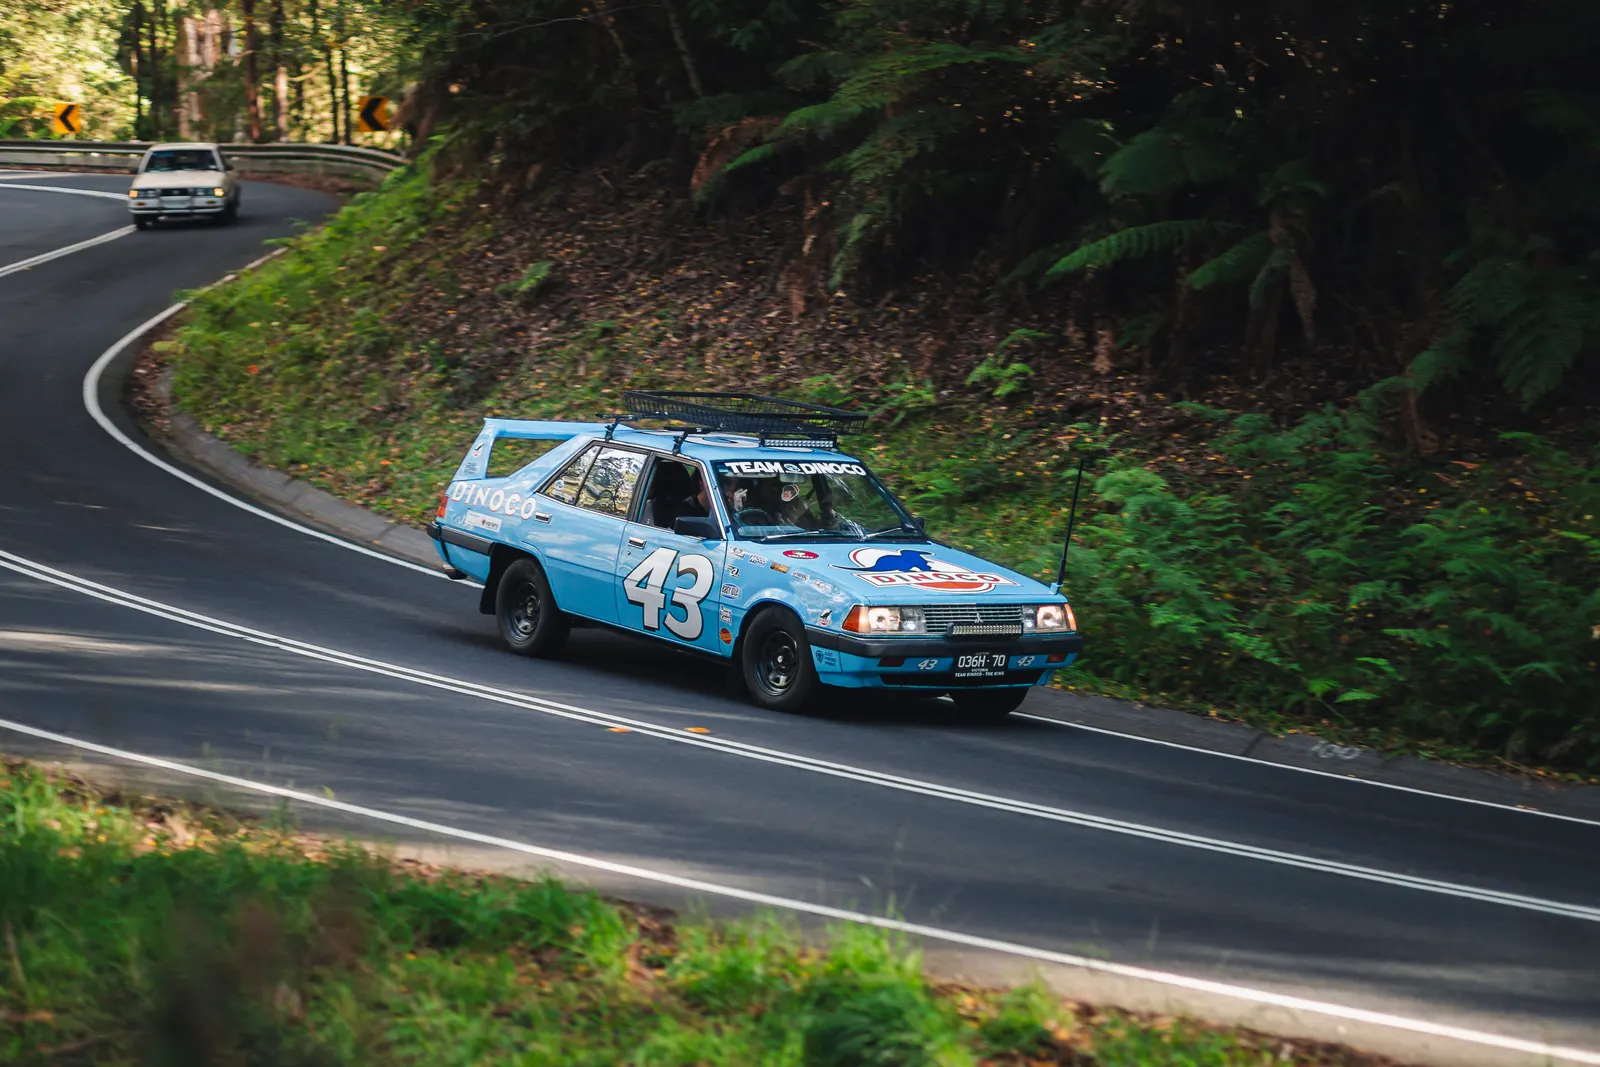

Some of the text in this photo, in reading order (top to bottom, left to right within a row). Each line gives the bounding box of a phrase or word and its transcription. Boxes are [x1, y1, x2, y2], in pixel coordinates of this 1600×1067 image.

[724, 461, 866, 476] TEAM DINOCO
[451, 481, 536, 520] DINOCO
[871, 573, 1001, 583] DINOCO
[622, 546, 714, 641] 43
[917, 659, 938, 670] 43
[1017, 655, 1035, 667] 43
